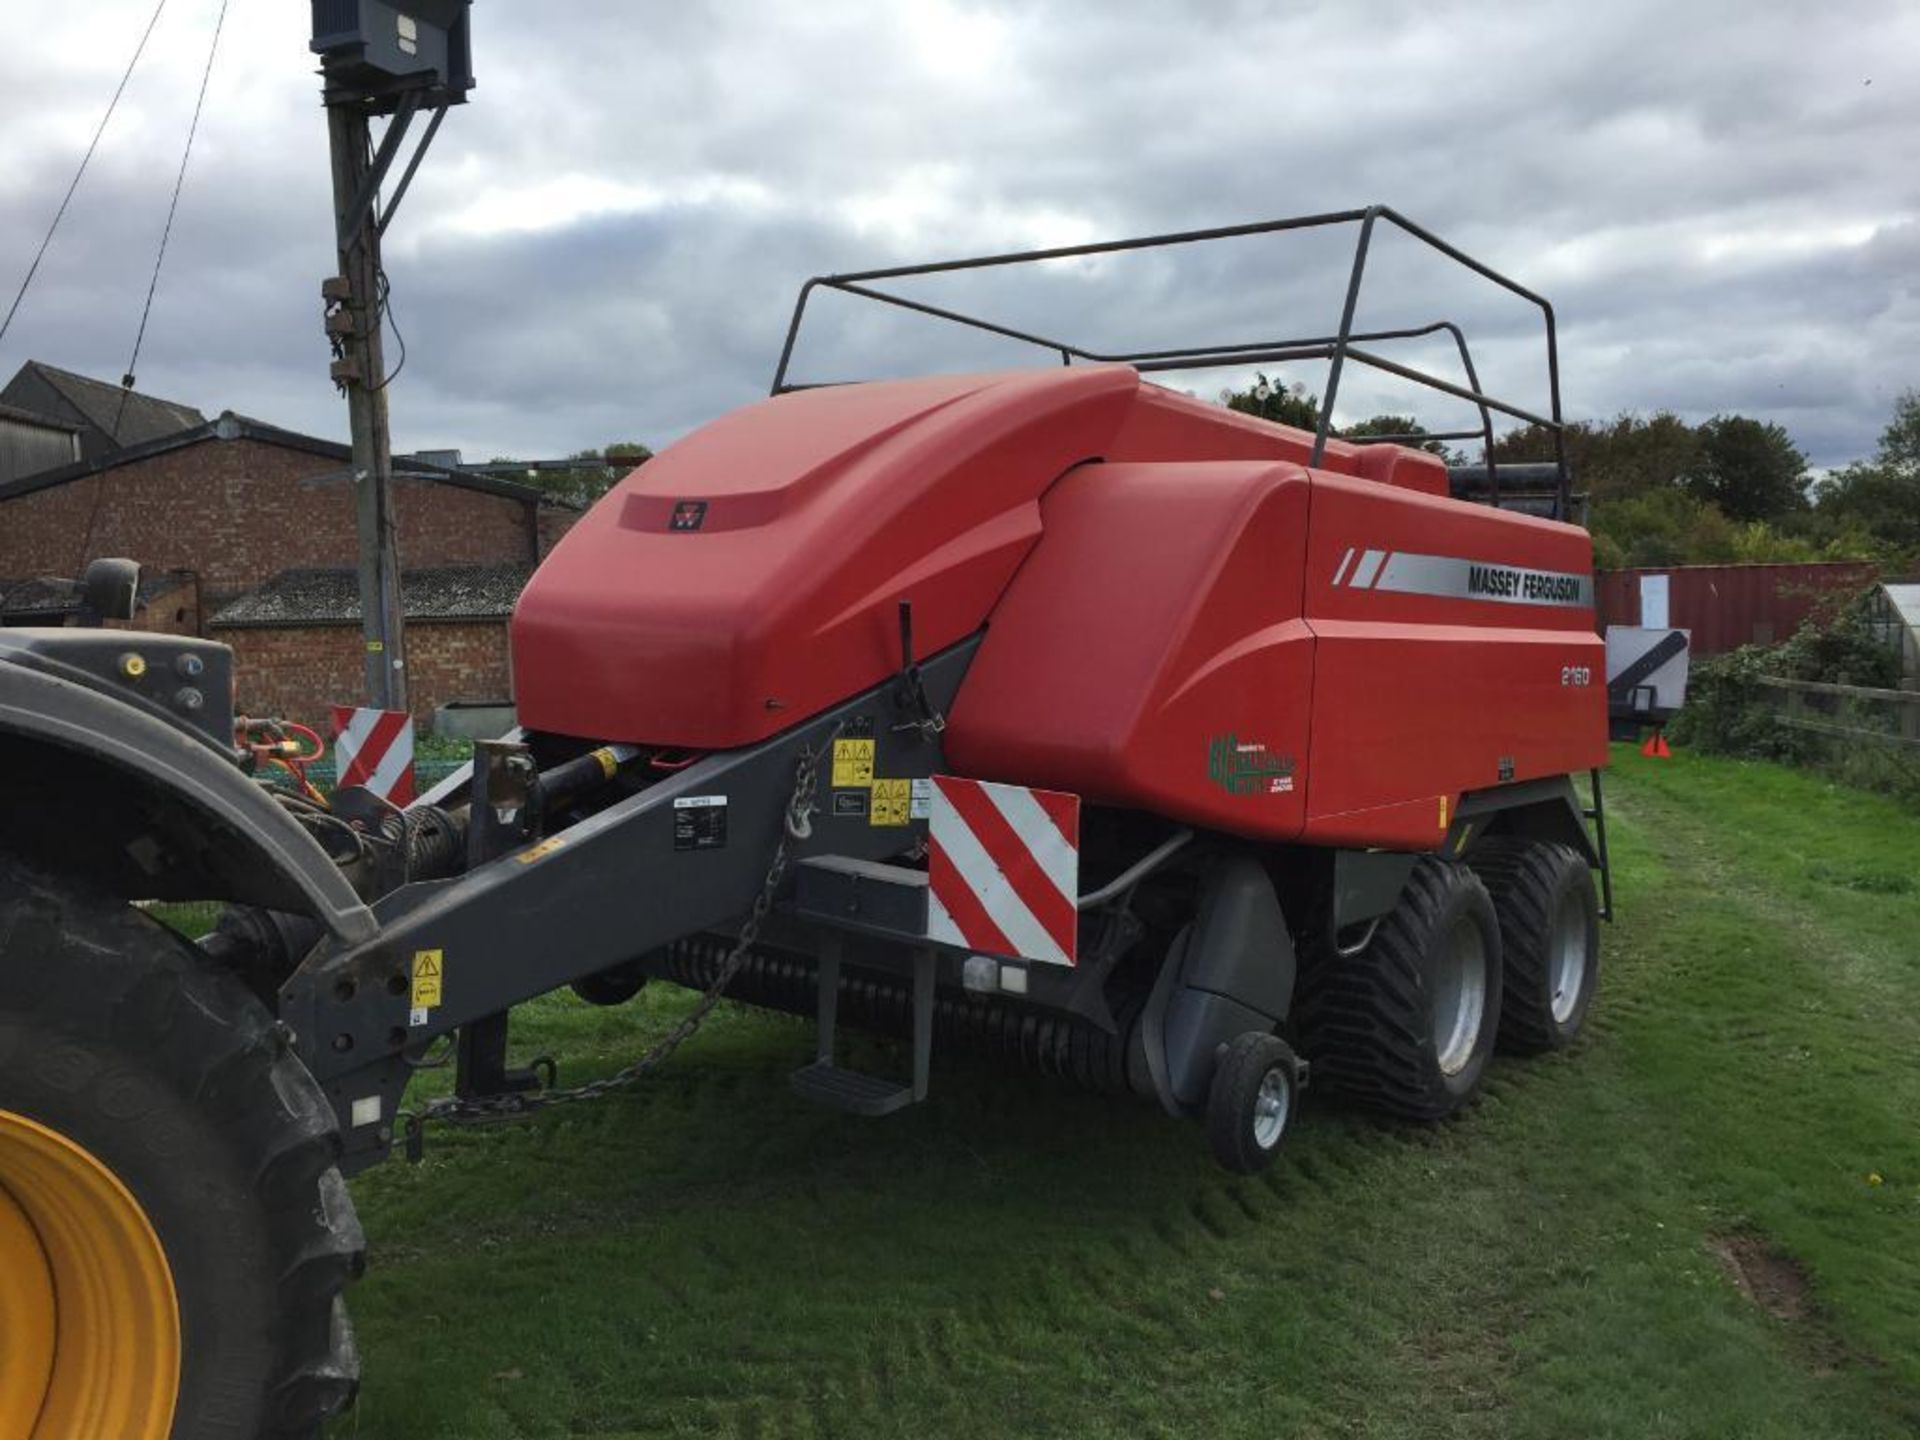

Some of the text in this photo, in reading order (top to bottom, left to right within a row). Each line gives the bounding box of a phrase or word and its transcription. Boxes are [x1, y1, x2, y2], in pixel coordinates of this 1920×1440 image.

[1468, 566, 1580, 601] MASSEY FERGUSON
[1561, 666, 1590, 685] 2160
